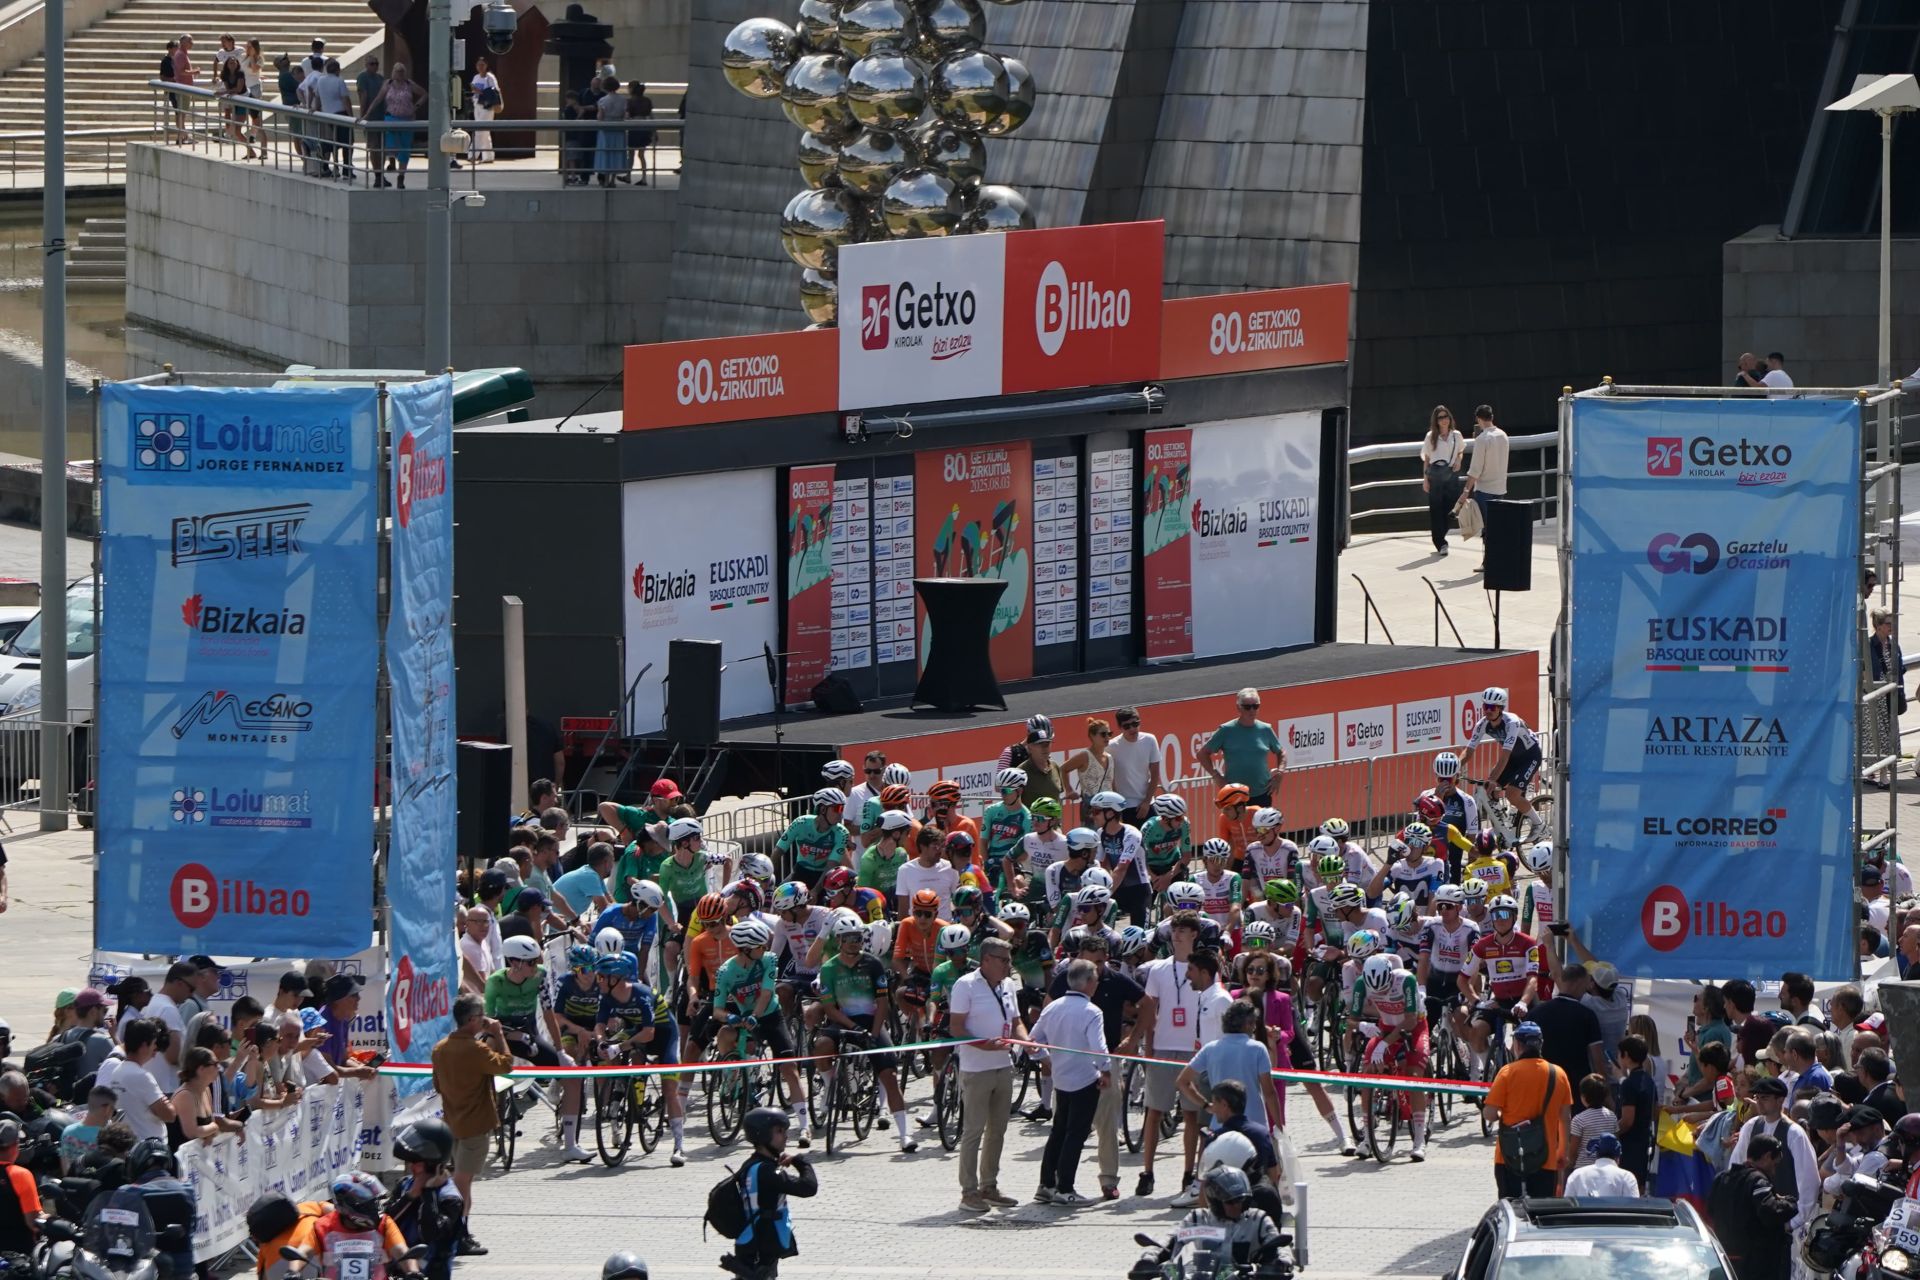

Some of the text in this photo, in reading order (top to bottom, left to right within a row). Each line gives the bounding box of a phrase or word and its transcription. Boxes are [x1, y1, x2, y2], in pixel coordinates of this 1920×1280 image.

[895, 281, 976, 330] Getxo
[1043, 280, 1131, 334] Bilbao
[1248, 308, 1301, 331] GETXOKO
[894, 333, 972, 353] KIROLAK bizi ezazu
[1209, 311, 1247, 355] 80.
[1247, 329, 1304, 351] ZIRKUITUA
[720, 354, 779, 380] GETXOKO
[677, 358, 718, 405] 80.
[720, 376, 784, 401] ZIRKUITUA
[196, 414, 346, 454] Loiumat
[970, 450, 1008, 464] GETXOKO
[1148, 444, 1163, 460] 80.
[1689, 436, 1792, 467] Getxo
[196, 459, 345, 473] JORGE FERNANDEZ
[944, 453, 970, 482] 80.
[970, 463, 1011, 479] ZIRKUITUA
[1689, 469, 1787, 483] KIROLAK bizi ezazu
[398, 448, 446, 506] Bilbao
[792, 482, 806, 499] 80.
[1259, 497, 1310, 523] EUSKADI
[1201, 506, 1248, 538] Bizkaia
[1258, 523, 1310, 539] BASQUE COUNTRY
[1726, 539, 1788, 555] Gaztelu
[710, 554, 769, 584] EUSKADI
[1726, 555, 1790, 570] Ocasión
[644, 569, 696, 604] Bizkaia
[709, 582, 769, 602] BASQUE COUNTRY
[201, 606, 305, 634] Bizkaia
[1647, 616, 1787, 643] EUSKADI
[1646, 648, 1788, 662] BASQUE COUNTRY
[1406, 709, 1441, 727] EUSKADI
[208, 733, 288, 744] MONTAJES
[1295, 728, 1325, 749] Bizkaia
[1357, 722, 1384, 740] Getxo
[1645, 716, 1788, 744] ARTAZA
[1645, 745, 1788, 758] HOTEL RESTAURANTE
[211, 786, 312, 814] Loiumat
[1643, 817, 1777, 836] EL CORREO
[1675, 840, 1777, 848] INFORMAZIO BALIOTSUA
[1261, 867, 1281, 876] UAE
[1477, 866, 1499, 876] UAE
[182, 878, 311, 917] Bilbao
[1653, 900, 1787, 938] Bilbao
[1439, 943, 1460, 951] UAE
[392, 973, 449, 1031] Bilbao
[1891, 1208, 1904, 1221] S
[1899, 1231, 1919, 1246] 59
[349, 1260, 362, 1274] S
